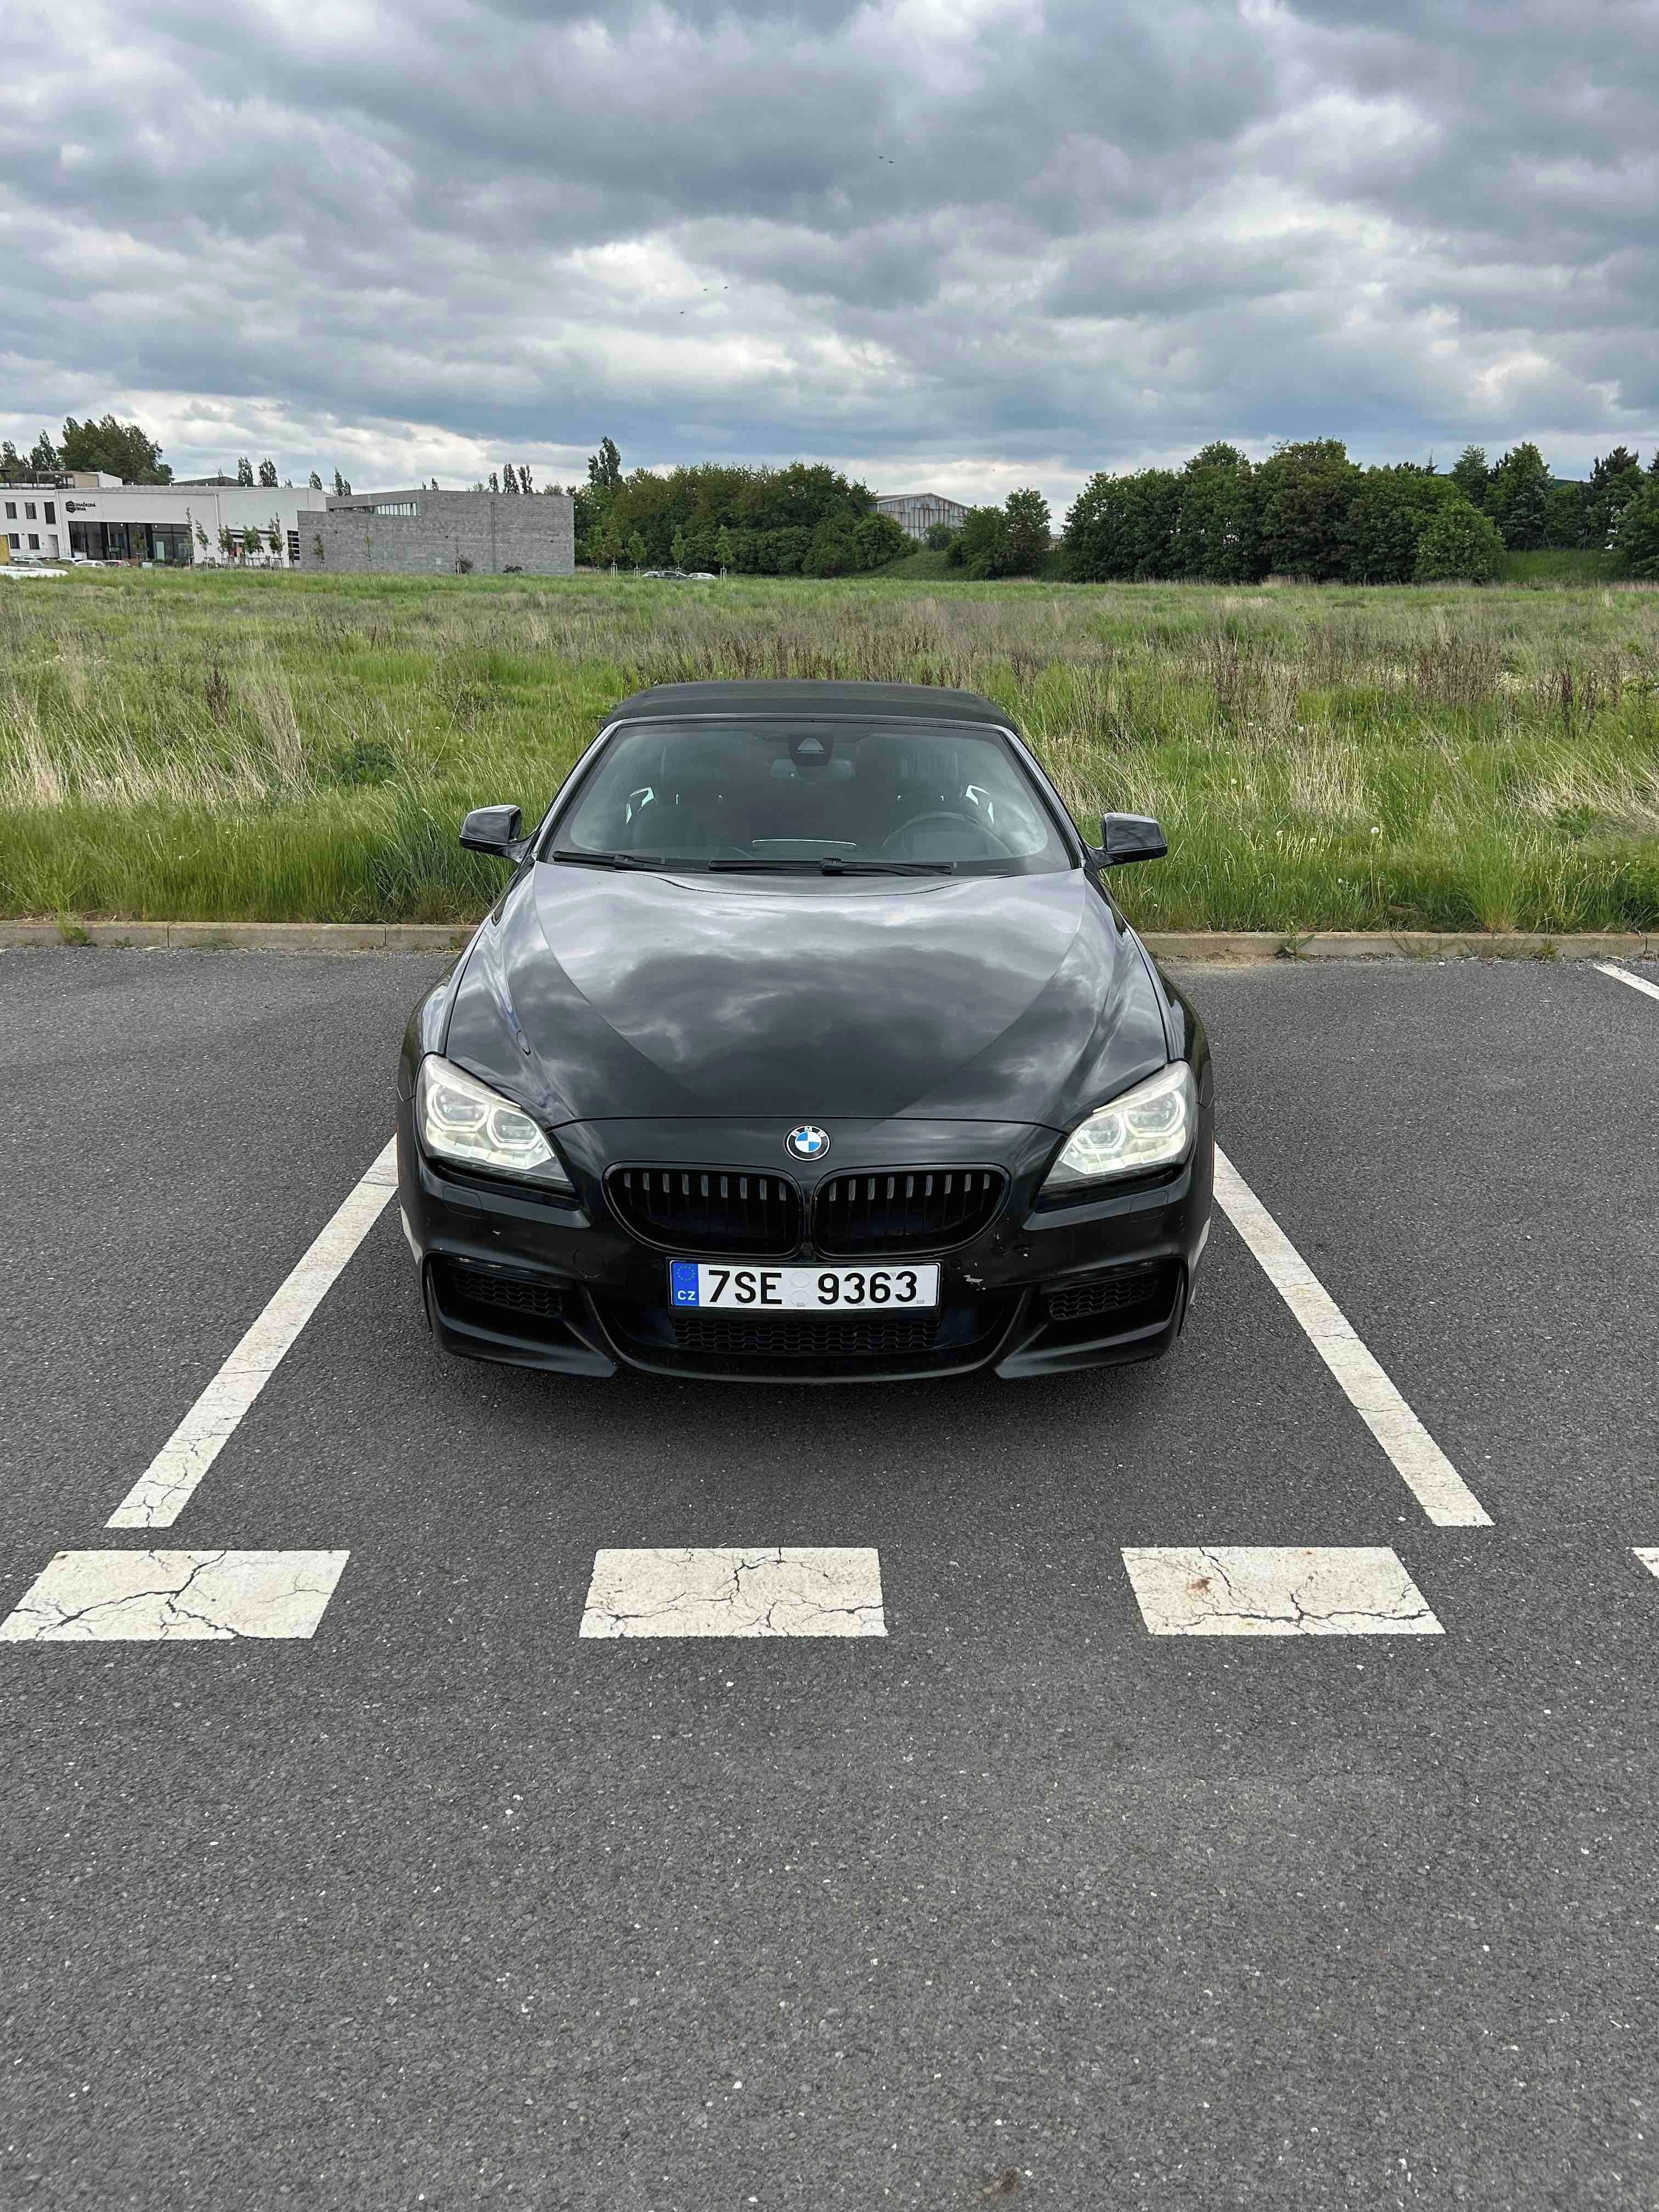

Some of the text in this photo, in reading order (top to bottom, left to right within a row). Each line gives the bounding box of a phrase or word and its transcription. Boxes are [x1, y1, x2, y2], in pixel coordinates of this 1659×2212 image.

[792, 1126, 826, 1137] BMW
[708, 1269, 917, 1305] 7SE 9363
[678, 1290, 696, 1300] CZ
